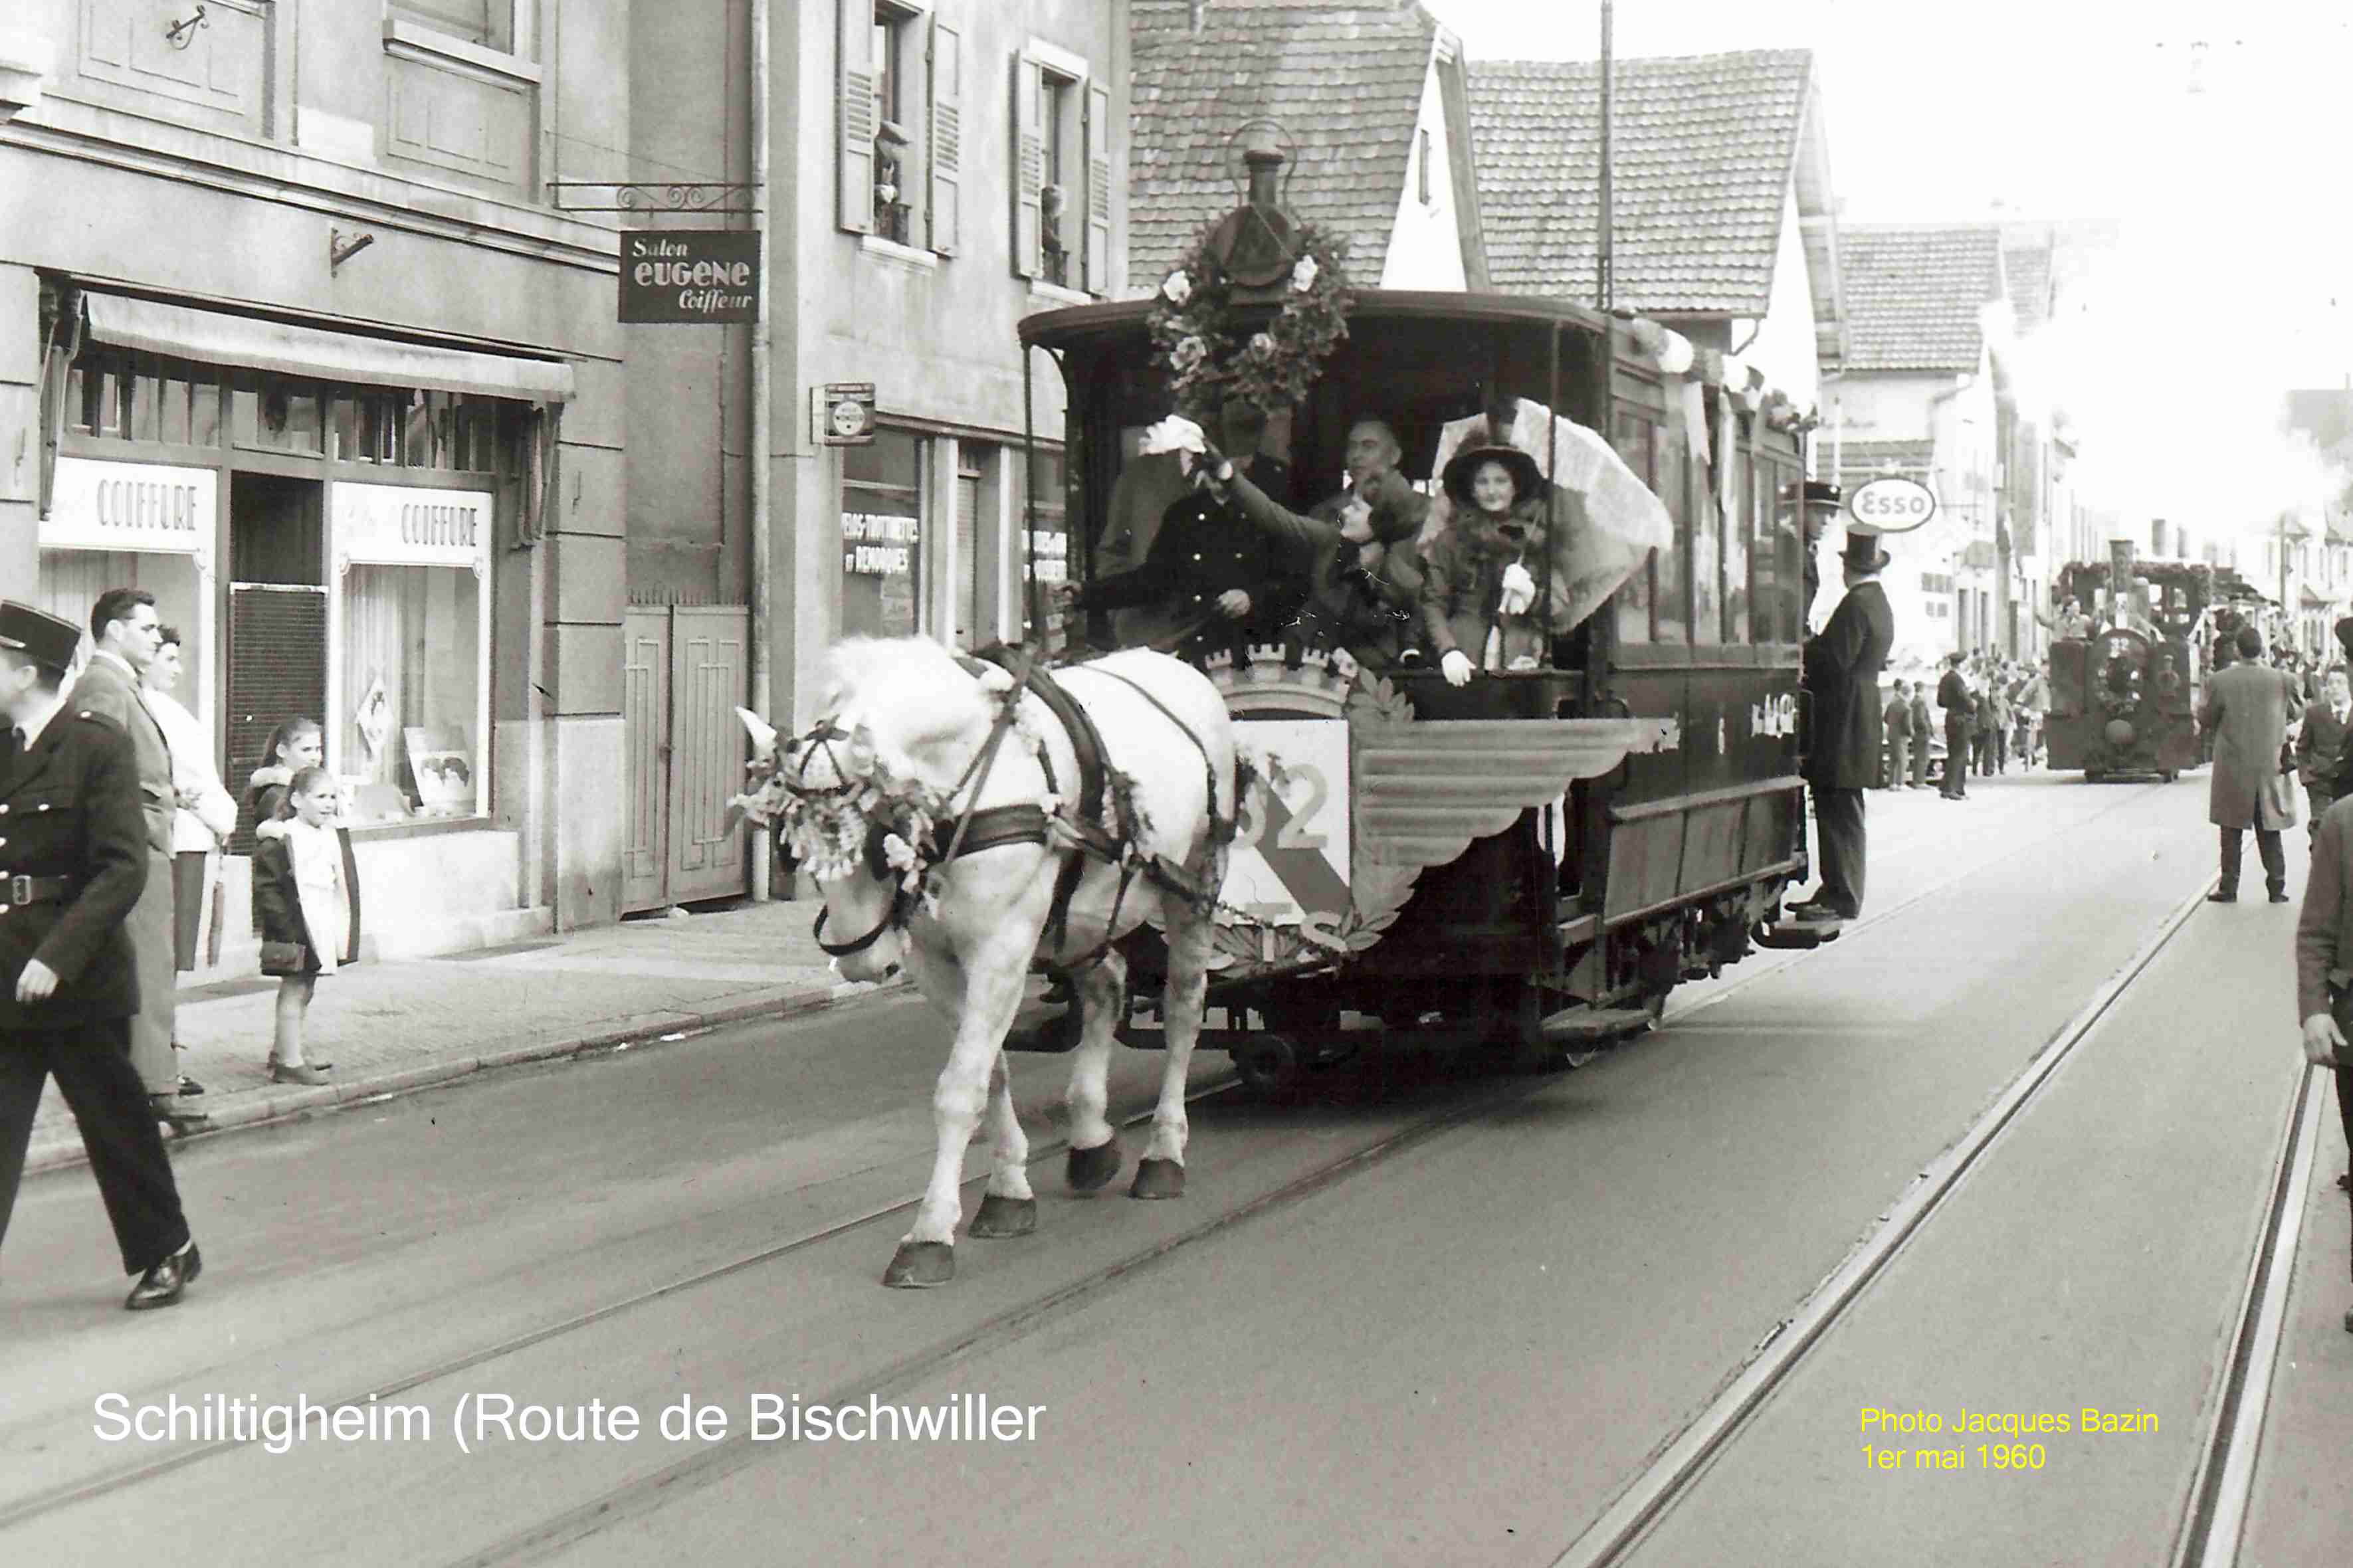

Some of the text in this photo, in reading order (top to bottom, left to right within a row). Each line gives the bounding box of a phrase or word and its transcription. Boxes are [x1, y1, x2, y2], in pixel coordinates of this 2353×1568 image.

[632, 238, 688, 257] Salon
[678, 288, 752, 314] Coiffeur
[97, 478, 197, 531] COIFFURE
[401, 504, 477, 547] COIFFURE
